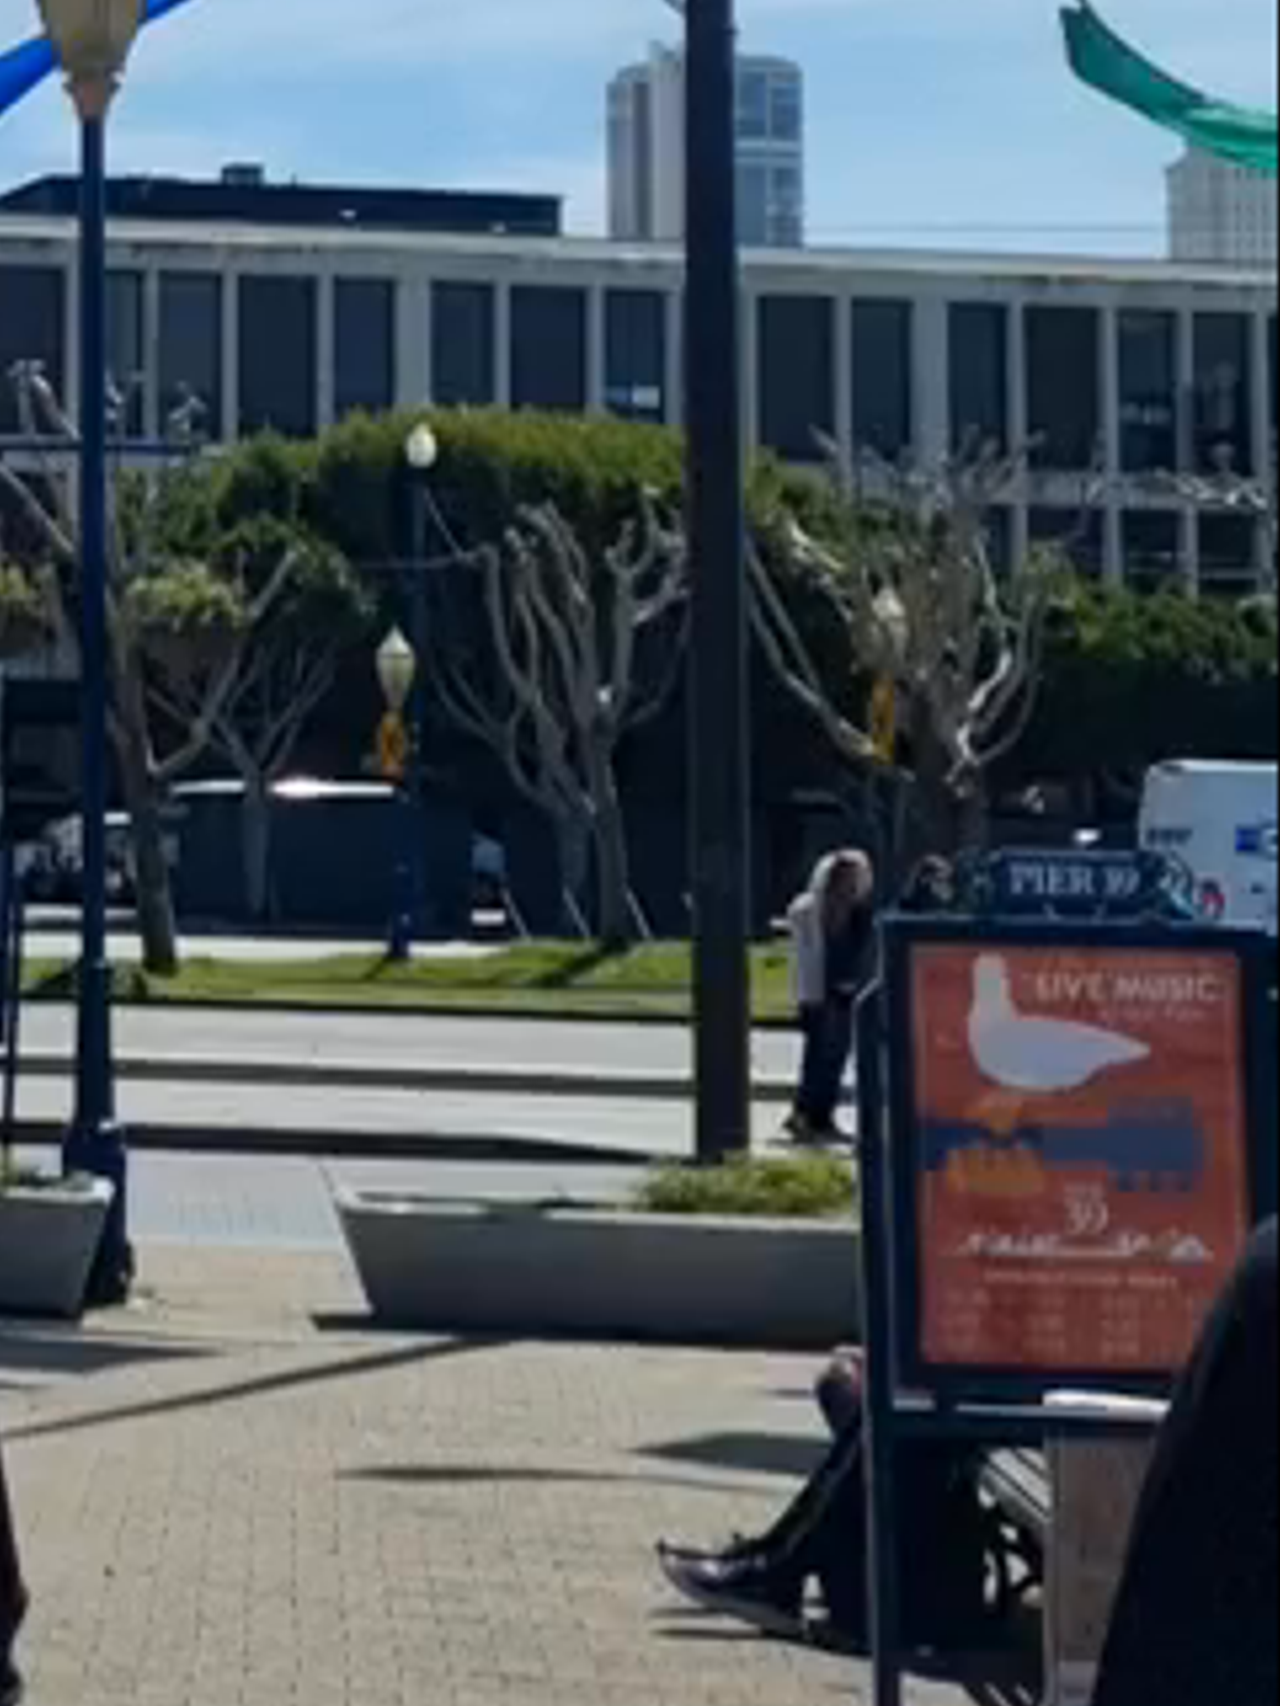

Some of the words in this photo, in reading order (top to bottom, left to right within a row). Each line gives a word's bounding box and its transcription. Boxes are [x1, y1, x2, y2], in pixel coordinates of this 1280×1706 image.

[1009, 863, 1094, 895] PIER
[1036, 972, 1104, 1002] LIVE
[1112, 974, 1220, 1003] MUSIC
